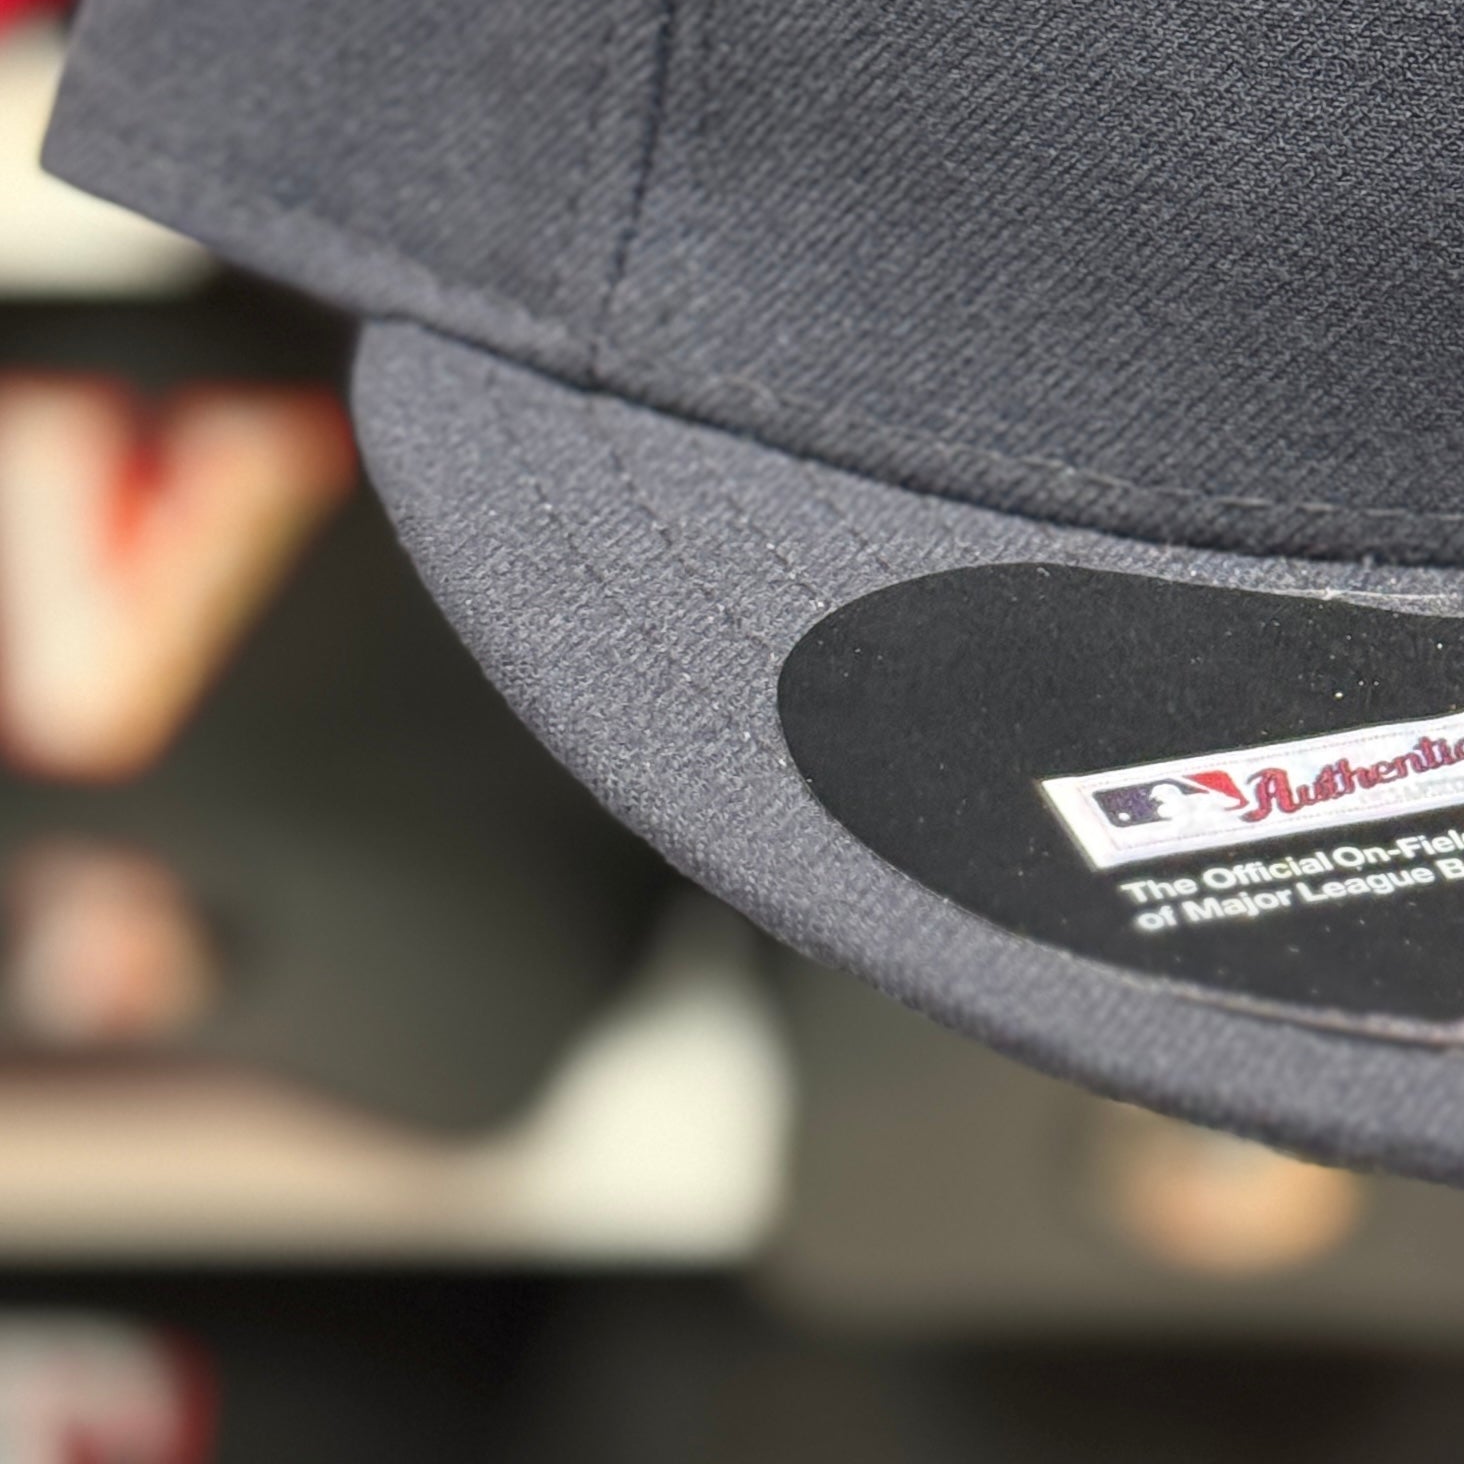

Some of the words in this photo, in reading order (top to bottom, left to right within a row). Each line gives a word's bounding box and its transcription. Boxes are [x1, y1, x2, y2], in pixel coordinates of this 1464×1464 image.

[1120, 878, 1199, 904] The
[1202, 850, 1335, 890] Official
[1136, 904, 1178, 931] of
[1181, 888, 1293, 923] Major
[1295, 866, 1436, 903] League
